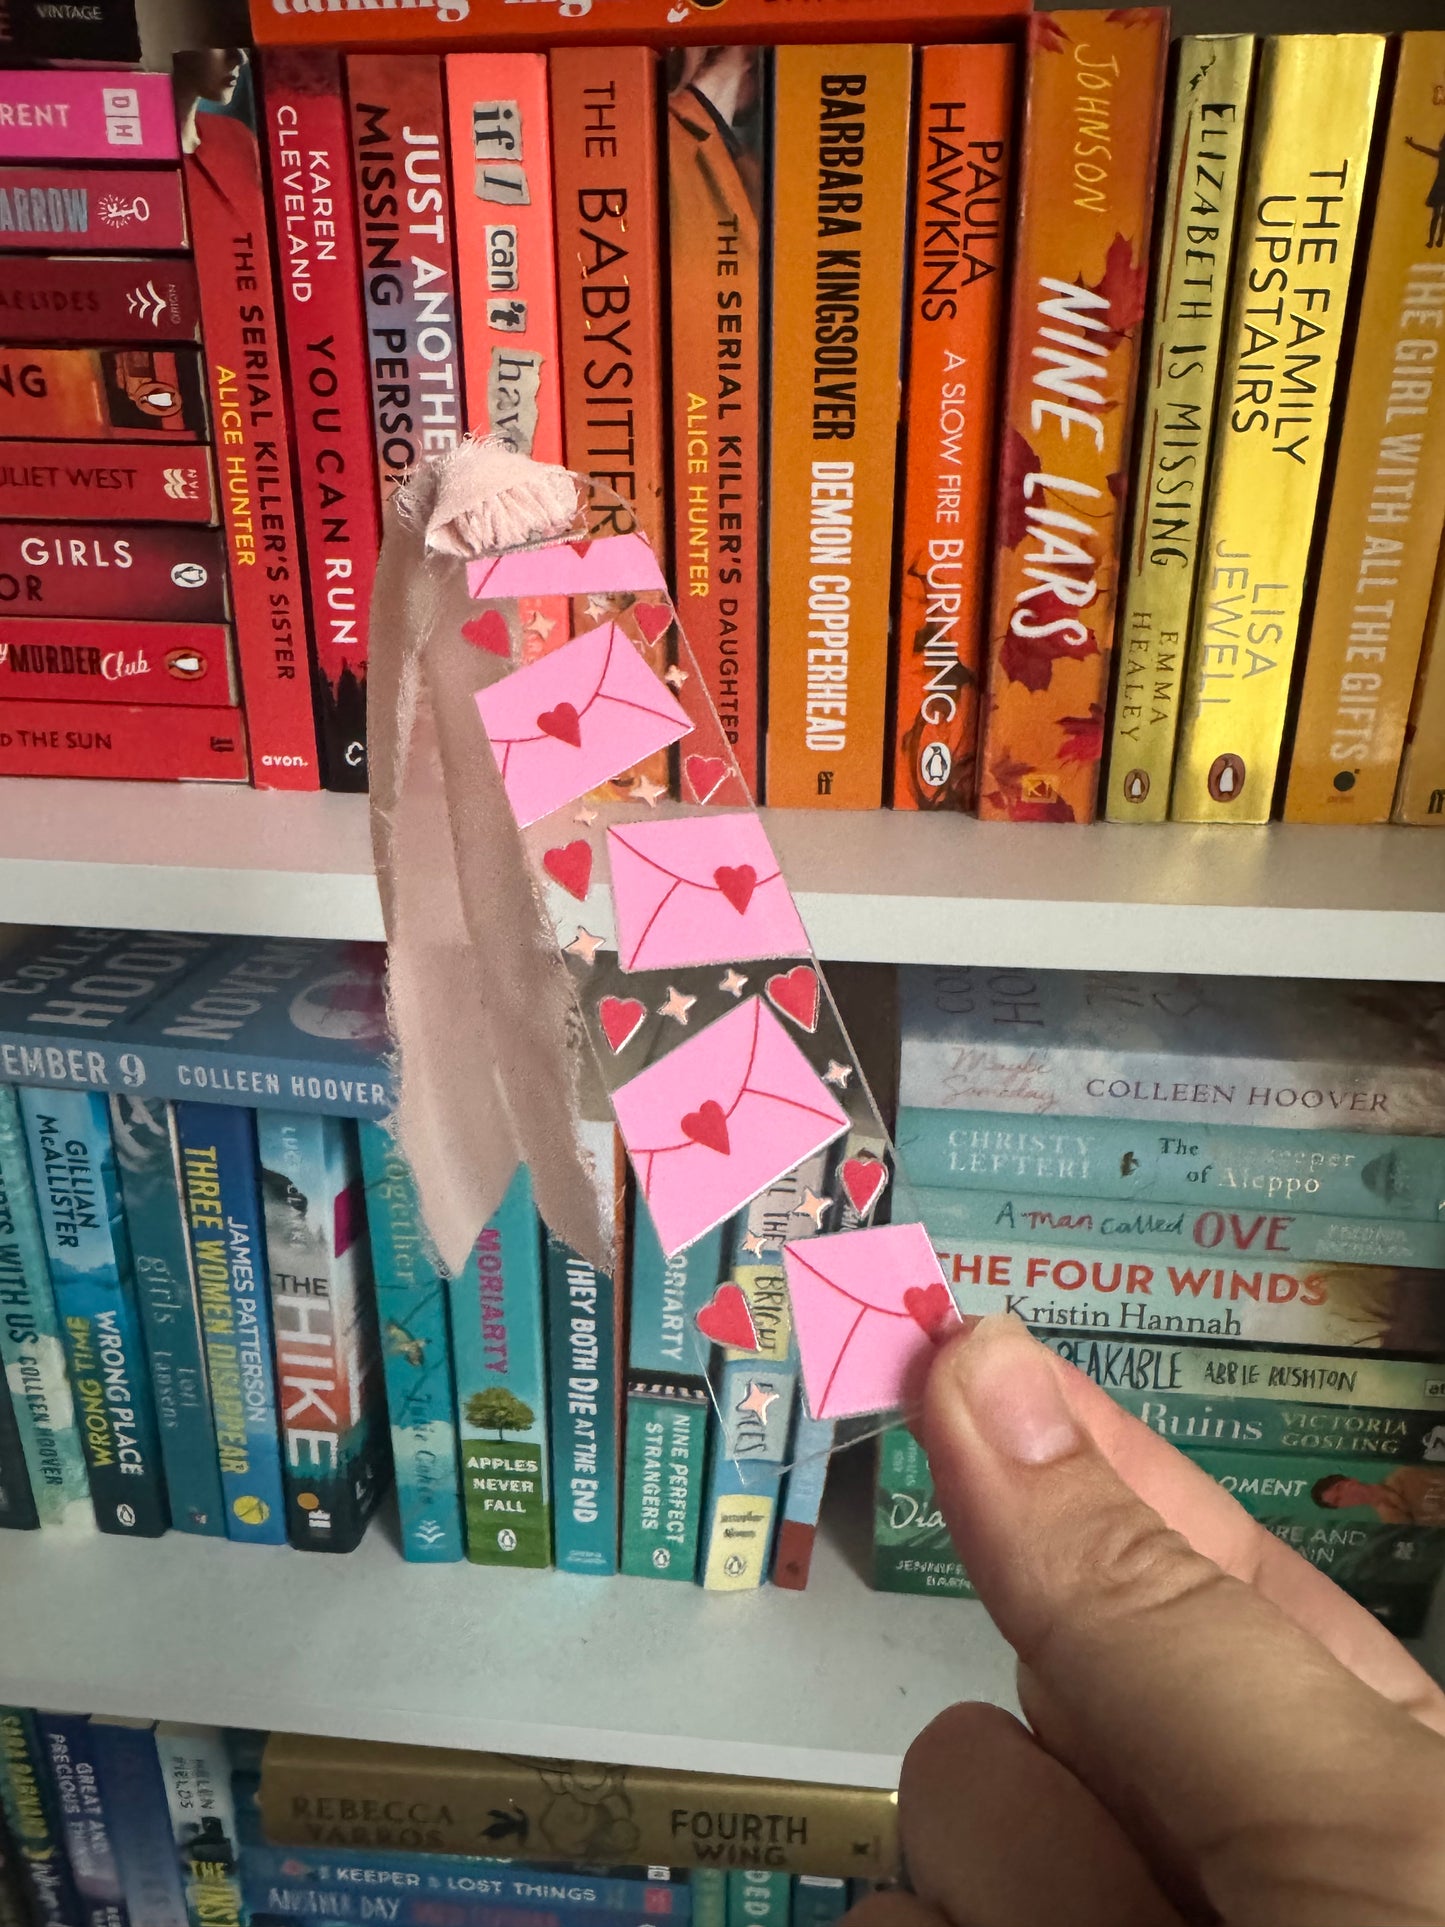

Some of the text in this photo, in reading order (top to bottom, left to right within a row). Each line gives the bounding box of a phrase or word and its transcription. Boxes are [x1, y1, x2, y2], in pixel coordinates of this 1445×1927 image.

[36, 5, 104, 20] VINTAGE
[473, 106, 516, 151] if
[1073, 44, 1120, 213] JOHNSON
[277, 105, 313, 303] CLEVELAND
[308, 151, 338, 261] KAREN
[356, 103, 403, 306] MISSING
[483, 170, 523, 195] I
[921, 102, 967, 322] HAWKINS
[961, 140, 1004, 287] PAULA
[402, 126, 458, 458] JUST ANOTHE
[578, 80, 640, 535] THE BABYSITTER
[1231, 195, 1297, 433] UPSTAIRS
[1272, 159, 1349, 465] THE FAMILY
[1150, 103, 1236, 569] ELIZABETH IS MISSING
[805, 74, 867, 752] BARBARA KINGSOLVER DEMON COPPERHEAD
[1386, 338, 1439, 425] GIRL
[65, 468, 138, 490] WEST
[215, 364, 256, 566] ALICE HUNTER
[233, 231, 296, 681] THE SERIAL KILLER'S SISTER
[717, 214, 744, 745] THE SERIAL KILLER'S DAUGHTER
[1009, 275, 1112, 647] NINE LIARS
[1367, 432, 1424, 523] WITH
[306, 334, 359, 644] YOU CAN RUN
[686, 392, 710, 598] ALICE HUNTER
[20, 537, 134, 568] GIRLS
[919, 350, 967, 726] A SLOW FIRE BURNING
[1355, 535, 1405, 594] ALL
[1198, 539, 1252, 718] JEWELL
[1242, 583, 1289, 679] LISA
[1346, 600, 1395, 663] THE
[10, 643, 102, 675] MURDER
[100, 649, 151, 681] Club
[1120, 611, 1152, 743] HEALEY
[1149, 630, 1179, 727] EMMA
[17, 729, 59, 748] THE
[65, 731, 113, 750] SUN
[1330, 672, 1383, 761] GIFTS
[119, 1053, 147, 1088] 9
[177, 1064, 280, 1095] COLLEEN
[290, 1075, 386, 1105] HOOVER
[1086, 1078, 1391, 1114] COLLEEN HOOVER
[948, 1151, 1091, 1179] LEFTERI
[949, 1129, 1096, 1155] CHRISTY
[1158, 1137, 1199, 1156] The
[65, 1138, 101, 1230] GILLIAN
[1186, 1164, 1321, 1199] of Aleppo
[995, 1201, 1016, 1229] A
[1022, 1210, 1094, 1230] man
[1100, 1211, 1185, 1239] called
[1192, 1210, 1297, 1252] OVE
[0, 1242, 30, 1308] WITH
[475, 1227, 510, 1374] MORIARTY
[566, 1258, 599, 1313] THEY
[658, 1254, 688, 1360] ORIARTY
[1025, 1257, 1155, 1295] FOUR
[1166, 1267, 1330, 1307] WINDS
[6, 1312, 40, 1347] US
[184, 1144, 249, 1475] THREE WOMEN DISAPPEAR
[227, 1216, 268, 1422] JAMES PATTERSON
[1005, 1294, 1243, 1336] Kristin Hannah
[274, 1273, 341, 1469] THE HIKE
[570, 1318, 599, 1369] BOTH
[94, 1310, 145, 1477] WRONG PLACE
[568, 1377, 599, 1416] DIE
[1204, 1361, 1260, 1386] ABBIE
[1267, 1365, 1359, 1393] RUSHTON
[78, 1381, 121, 1468] WRONG
[574, 1418, 595, 1440] AT
[1141, 1400, 1409, 1441] Ruins VICTORIA
[1280, 1431, 1401, 1455] GOSLING
[467, 1456, 539, 1473] APPLES
[473, 1478, 534, 1493] NEVER
[573, 1443, 597, 1474] THE
[641, 1421, 664, 1530] STRANGERS
[666, 1413, 691, 1543] NINE PERFECT
[1218, 1475, 1309, 1498] OMENT
[484, 1499, 526, 1513] FALL
[570, 1478, 599, 1523] END
[1310, 1528, 1368, 1548] AND
[289, 1797, 454, 1828] REBECCA
[671, 1808, 808, 1846] FOURTH
[336, 1866, 421, 1888] KEEPER
[448, 1876, 502, 1893] LOST
[513, 1882, 597, 1902] THINGS
[691, 1840, 789, 1868] WING
